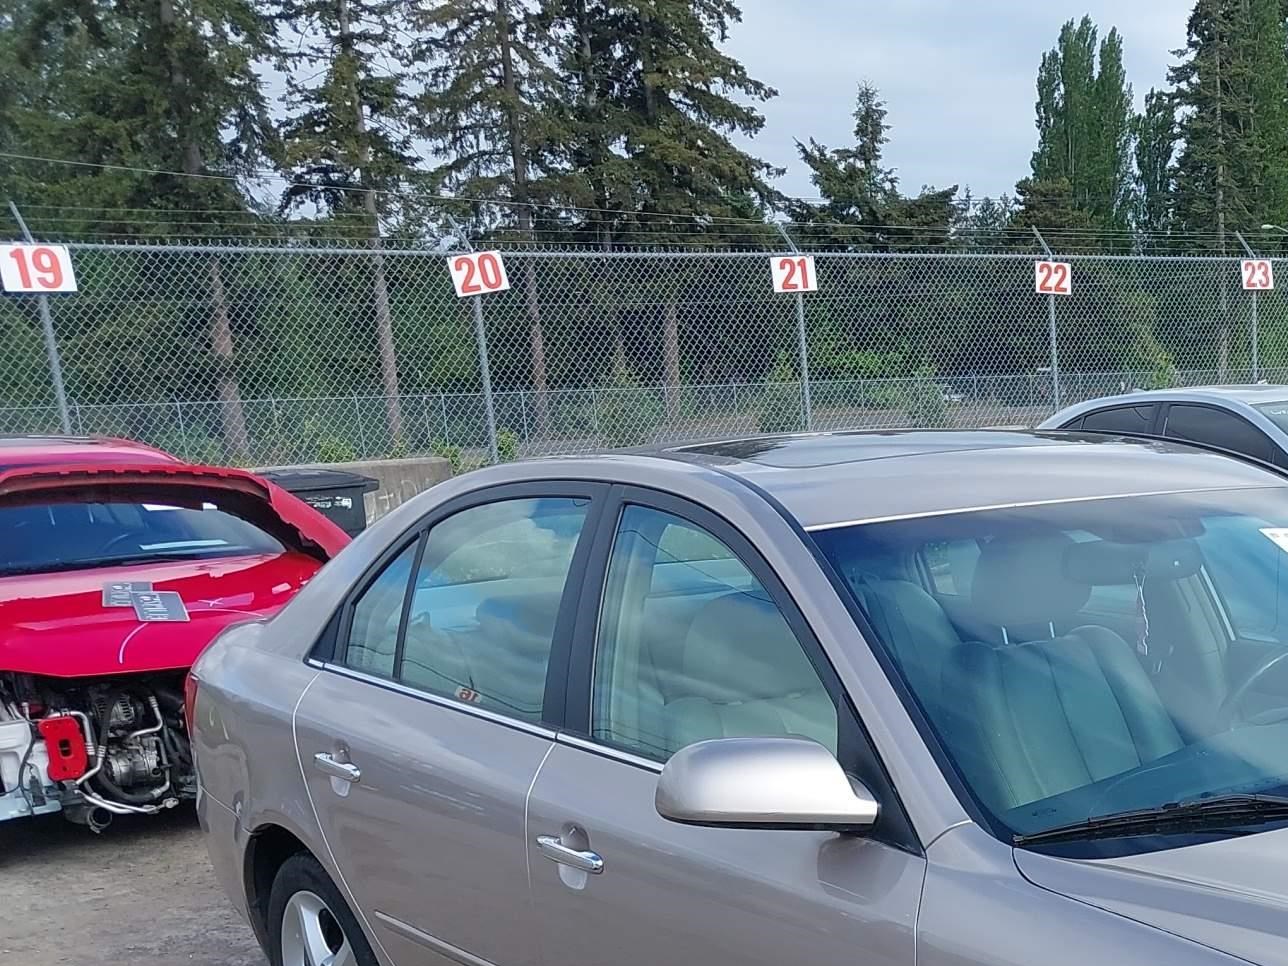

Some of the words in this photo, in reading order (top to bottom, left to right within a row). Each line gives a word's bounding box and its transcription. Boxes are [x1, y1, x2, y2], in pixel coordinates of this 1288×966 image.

[9, 248, 63, 288] 19
[455, 254, 502, 293] 20
[780, 258, 808, 290] 21
[1039, 263, 1067, 292] 22
[1244, 262, 1270, 287] 23
